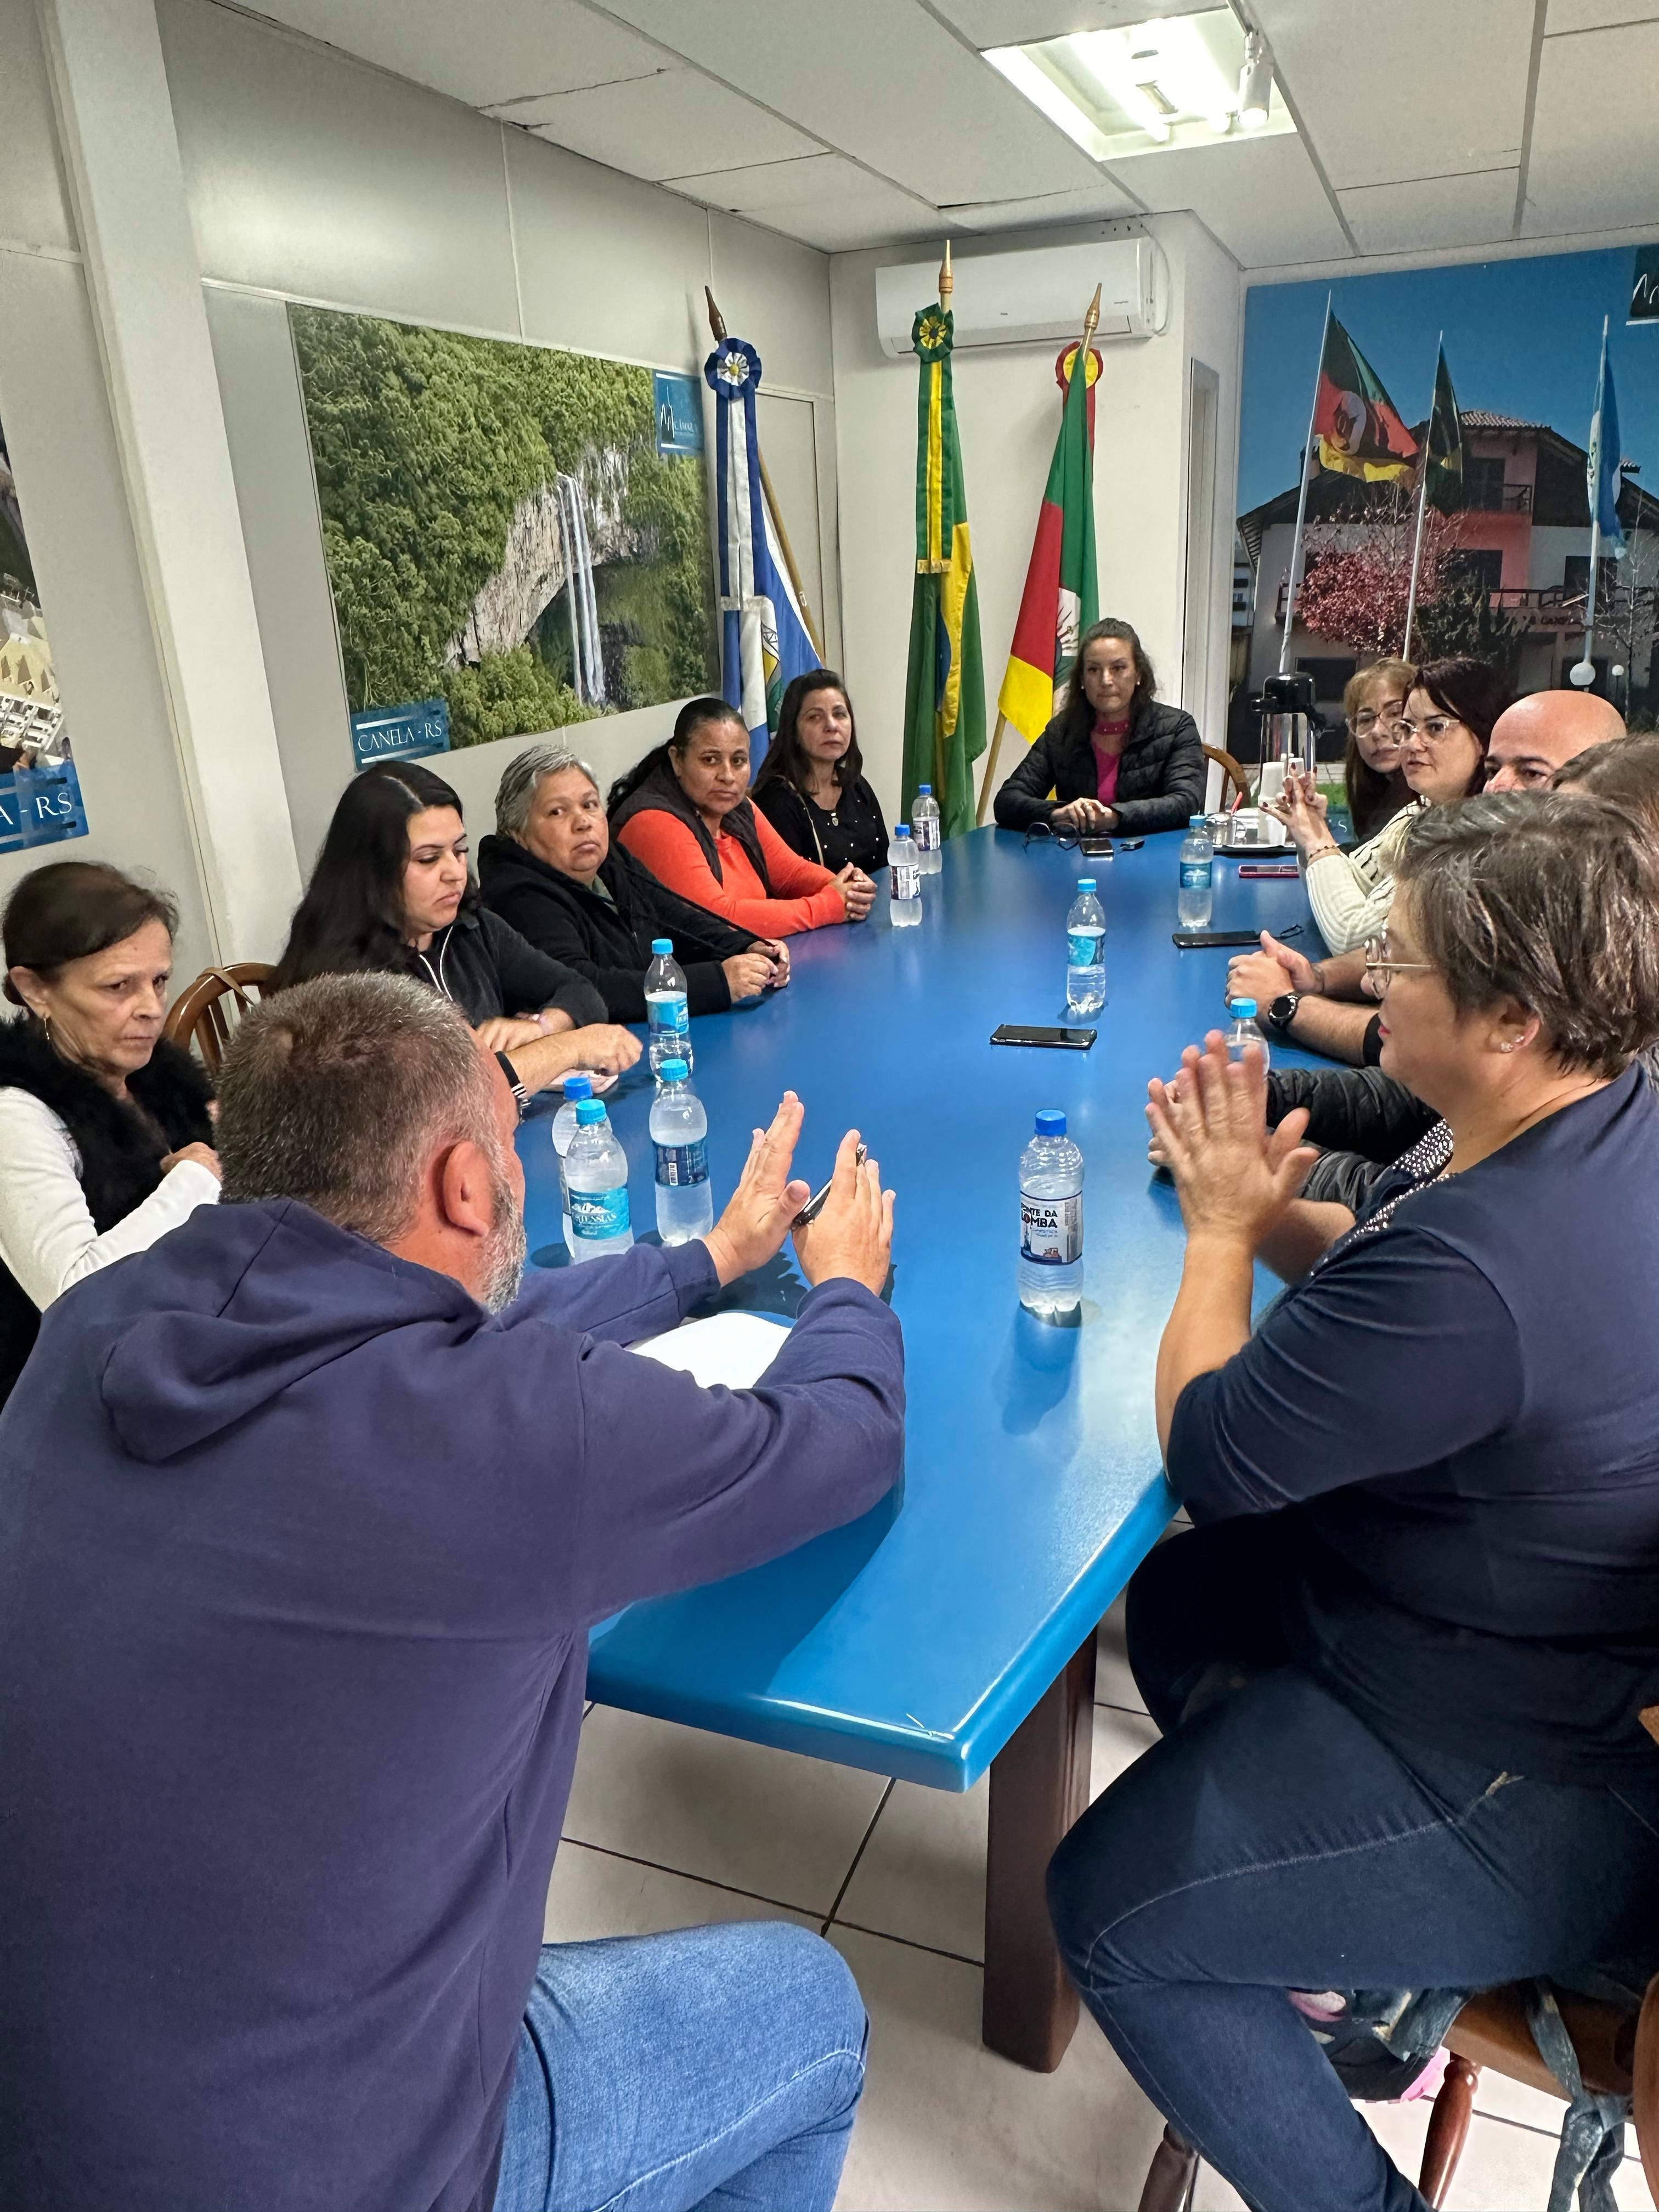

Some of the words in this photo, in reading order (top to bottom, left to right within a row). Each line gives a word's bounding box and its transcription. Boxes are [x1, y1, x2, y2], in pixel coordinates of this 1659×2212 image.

[358, 727, 415, 752] CANELA
[425, 720, 442, 738] RS
[36, 792, 72, 819] RS
[1045, 1210, 1058, 1218] DA
